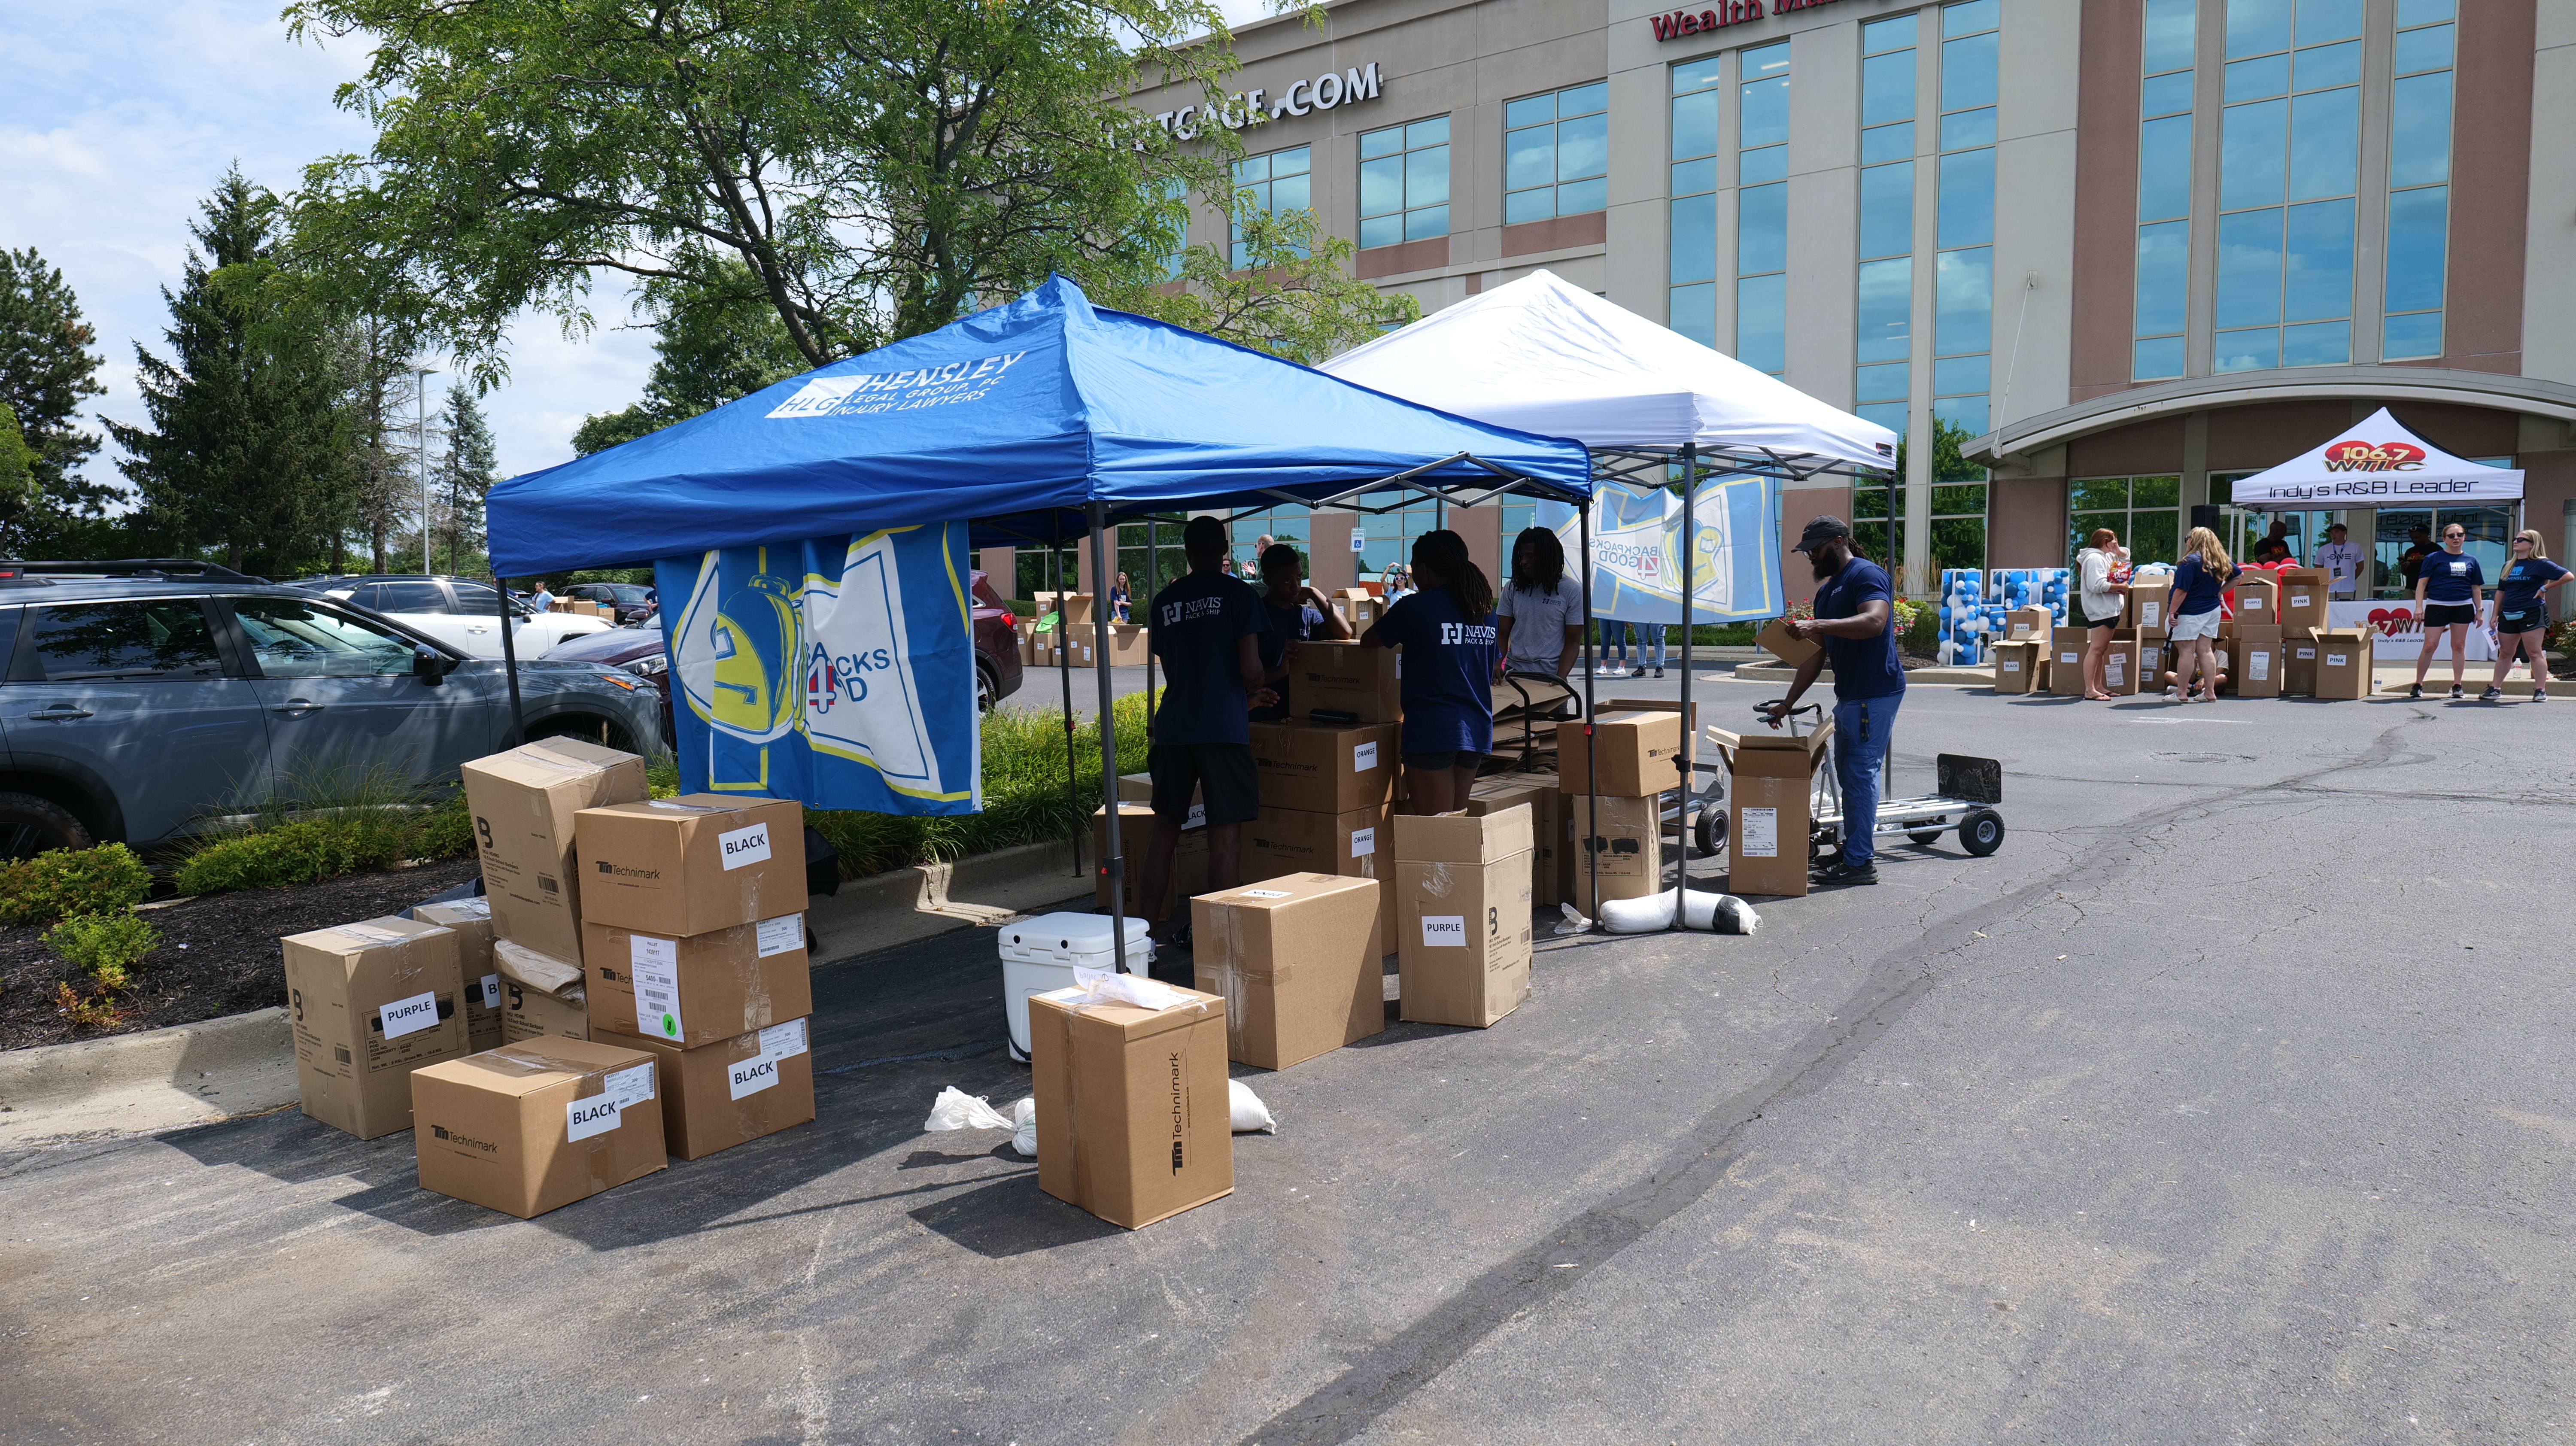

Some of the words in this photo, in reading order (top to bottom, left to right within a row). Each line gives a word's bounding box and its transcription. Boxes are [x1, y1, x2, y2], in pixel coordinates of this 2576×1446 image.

[1650, 0, 1763, 42] Wealth
[858, 351, 1027, 392] HENSLEY
[841, 392, 897, 404] LEGAL
[905, 383, 968, 396] GROUP,
[981, 376, 1005, 386] PC
[778, 396, 839, 412] HLG
[828, 402, 898, 416] INJURY
[896, 389, 990, 410] LAWYERS
[2341, 447, 2410, 460] 106.7
[2322, 459, 2428, 472] WTLC
[2270, 485, 2330, 499] Indy's
[2336, 481, 2387, 495] R&B
[2394, 479, 2479, 493] Leader
[1186, 597, 1221, 613] NAVIS
[1186, 612, 1200, 620] PACK
[1465, 625, 1495, 638] NAVIS
[1321, 675, 1360, 684] Technimark
[1357, 748, 1375, 758] ORANGE
[1273, 761, 1317, 772] Technimark
[477, 816, 493, 848] B
[1354, 834, 1372, 844] ORANGE
[726, 833, 765, 854] BLACK
[1270, 841, 1314, 854] Technimark
[613, 865, 660, 879] Technimark
[1123, 838, 1131, 886] Technimark
[293, 988, 304, 1021] B
[388, 1001, 431, 1021] PURPLE
[371, 1048, 396, 1057] COMMODITY
[735, 1061, 773, 1084] BLACK
[1169, 1052, 1182, 1140] Technimark
[574, 1101, 616, 1124] BLACK
[450, 1131, 498, 1153] Technimark
